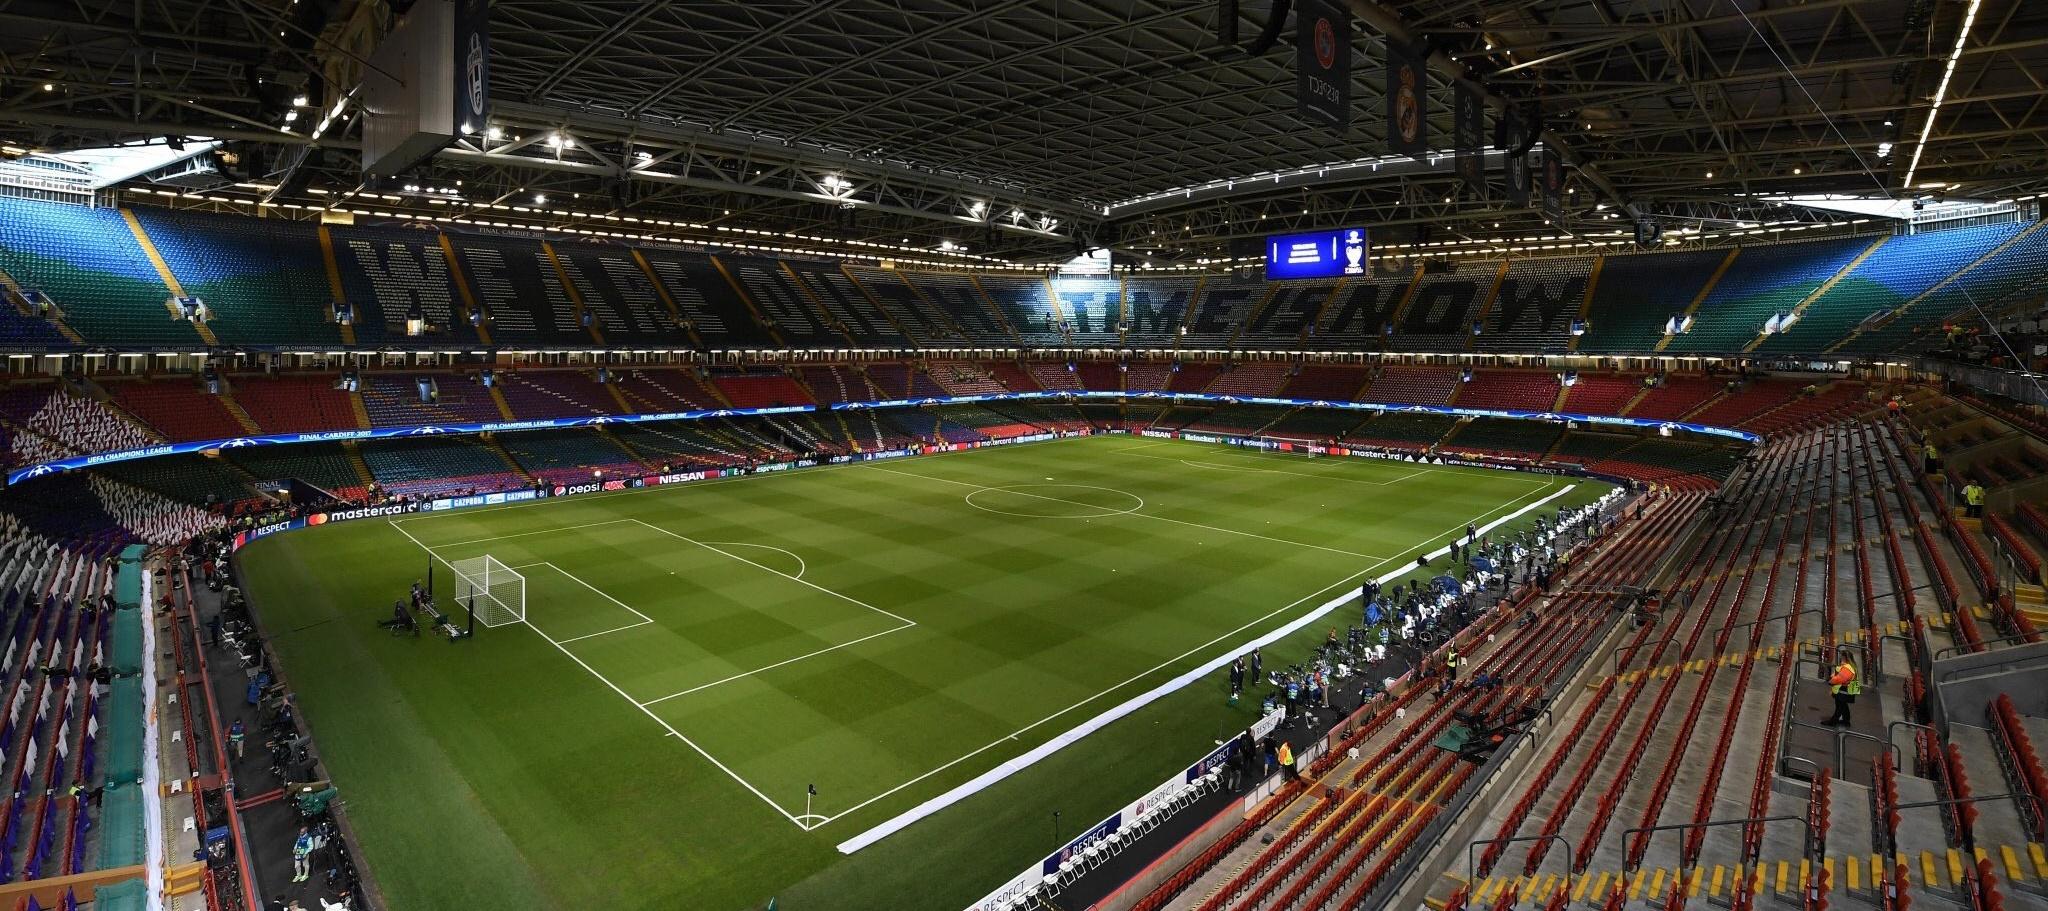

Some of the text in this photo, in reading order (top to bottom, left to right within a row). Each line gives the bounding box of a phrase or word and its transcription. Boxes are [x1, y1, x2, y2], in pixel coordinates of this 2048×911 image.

[1141, 430, 1171, 439] NISSAN
[1184, 434, 1216, 443] Heineken
[87, 445, 173, 464] UEFA CHAMPIONS LEAGUE
[875, 449, 905, 459] PlayStation
[1531, 467, 1558, 475] RESPECT
[659, 471, 704, 484] NISSAN
[255, 480, 281, 490] FINAL
[568, 483, 600, 495] pepsi
[454, 496, 484, 507] GAZPROM
[507, 491, 535, 502] GAZPROM
[257, 521, 291, 536] RESPECT
[1256, 717, 1277, 734] RESPECT
[1206, 747, 1230, 769] RESPECT
[1146, 783, 1175, 809] RESPECT
[1073, 825, 1107, 856] RESPECT
[983, 879, 1026, 911] RESPECT
